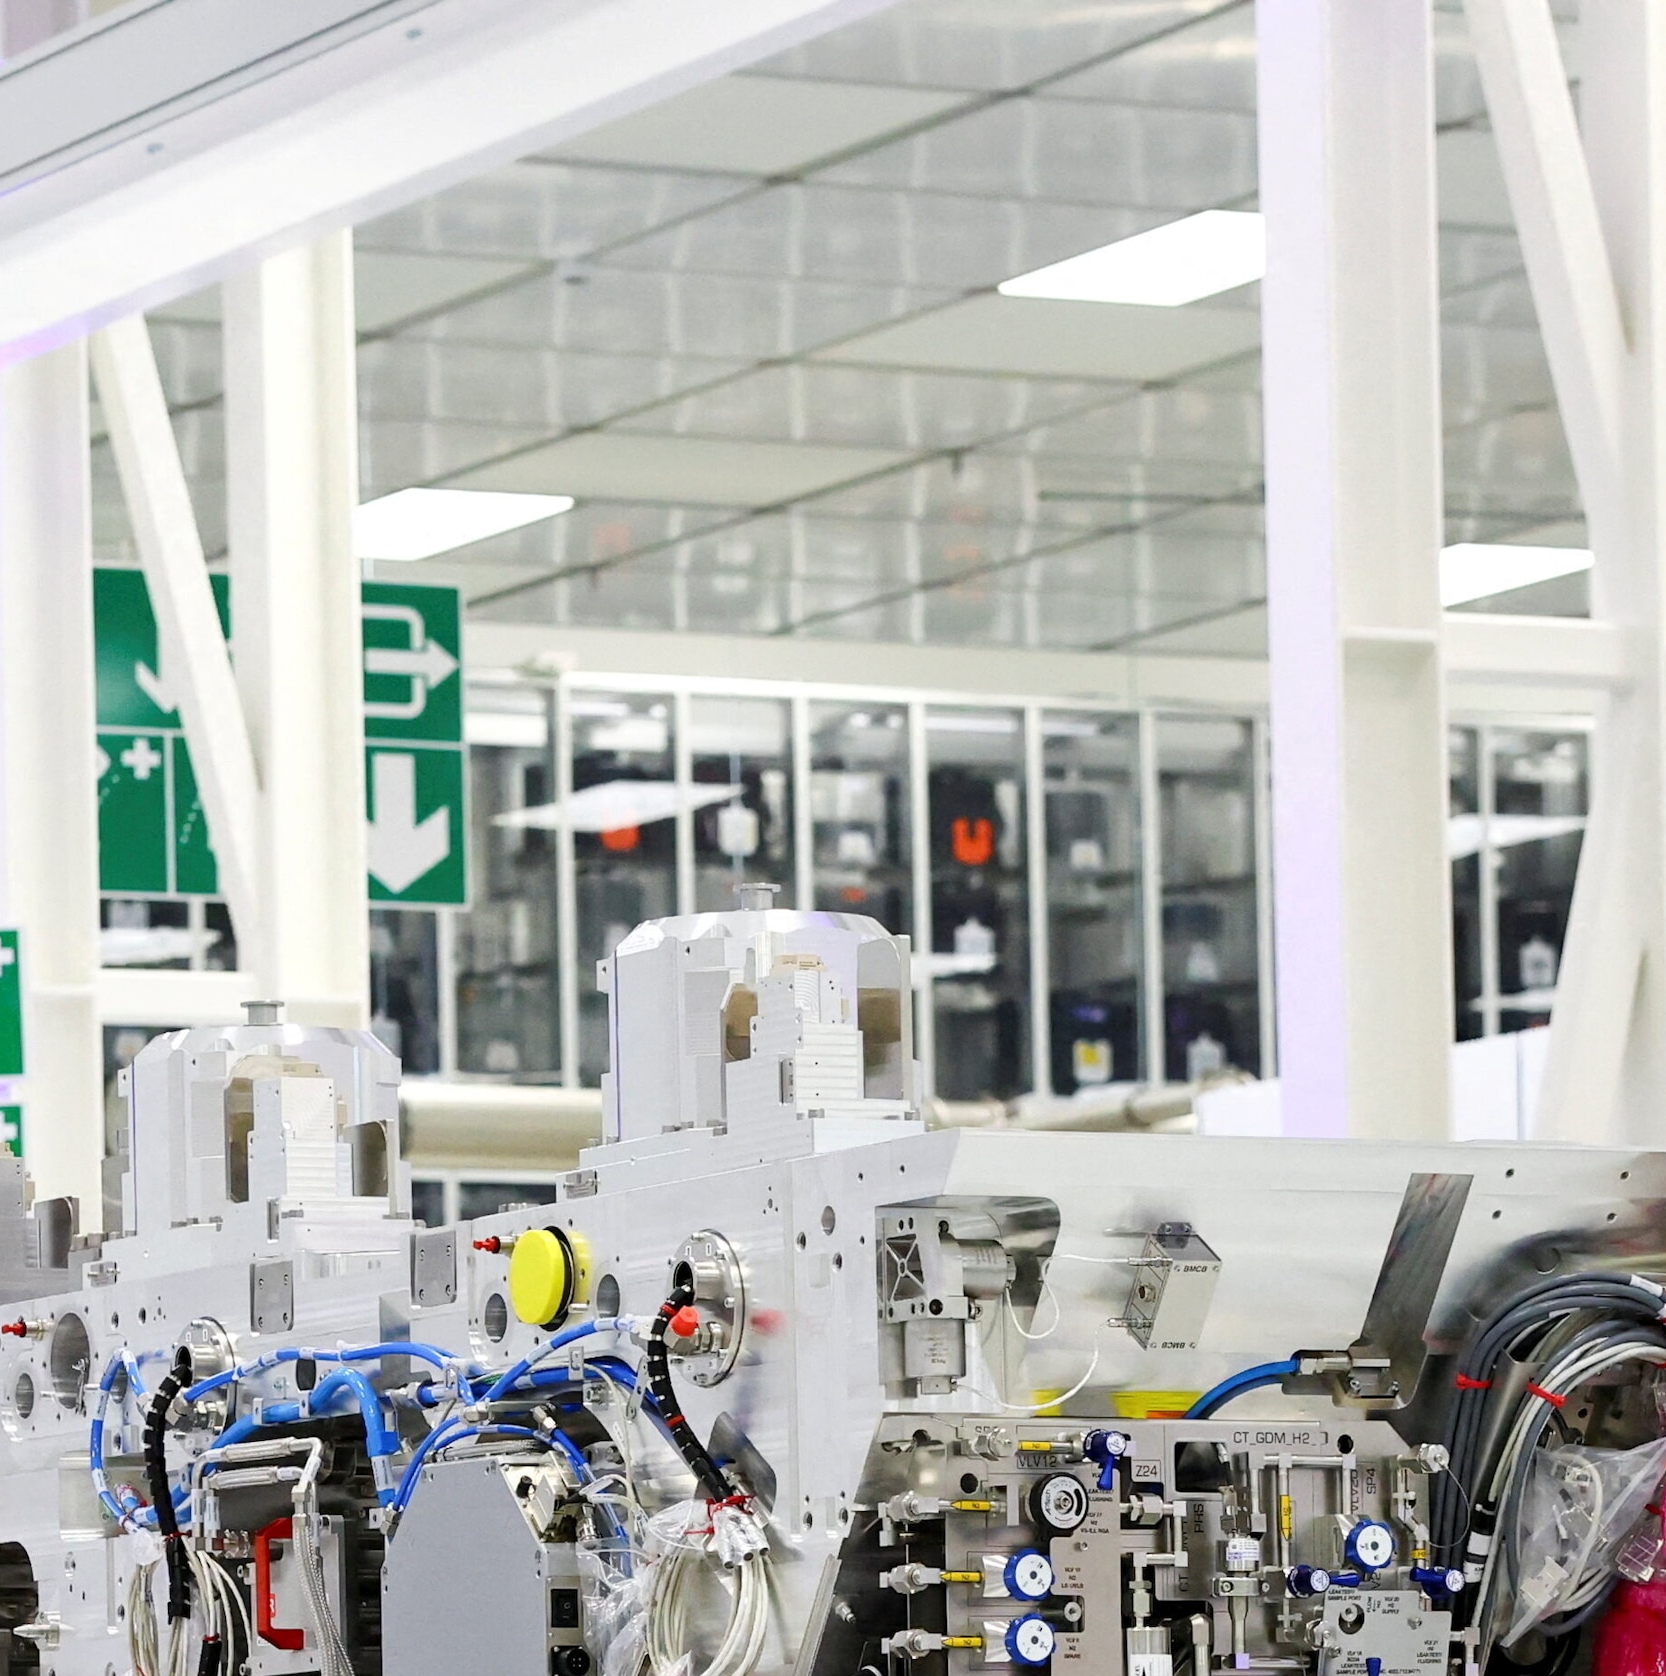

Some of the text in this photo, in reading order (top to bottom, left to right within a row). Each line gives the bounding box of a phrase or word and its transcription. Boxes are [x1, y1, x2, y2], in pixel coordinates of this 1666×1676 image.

[1018, 1456, 1058, 1468] VLV12
[1136, 1464, 1158, 1477] Z24
[1367, 1467, 1376, 1495] SP4
